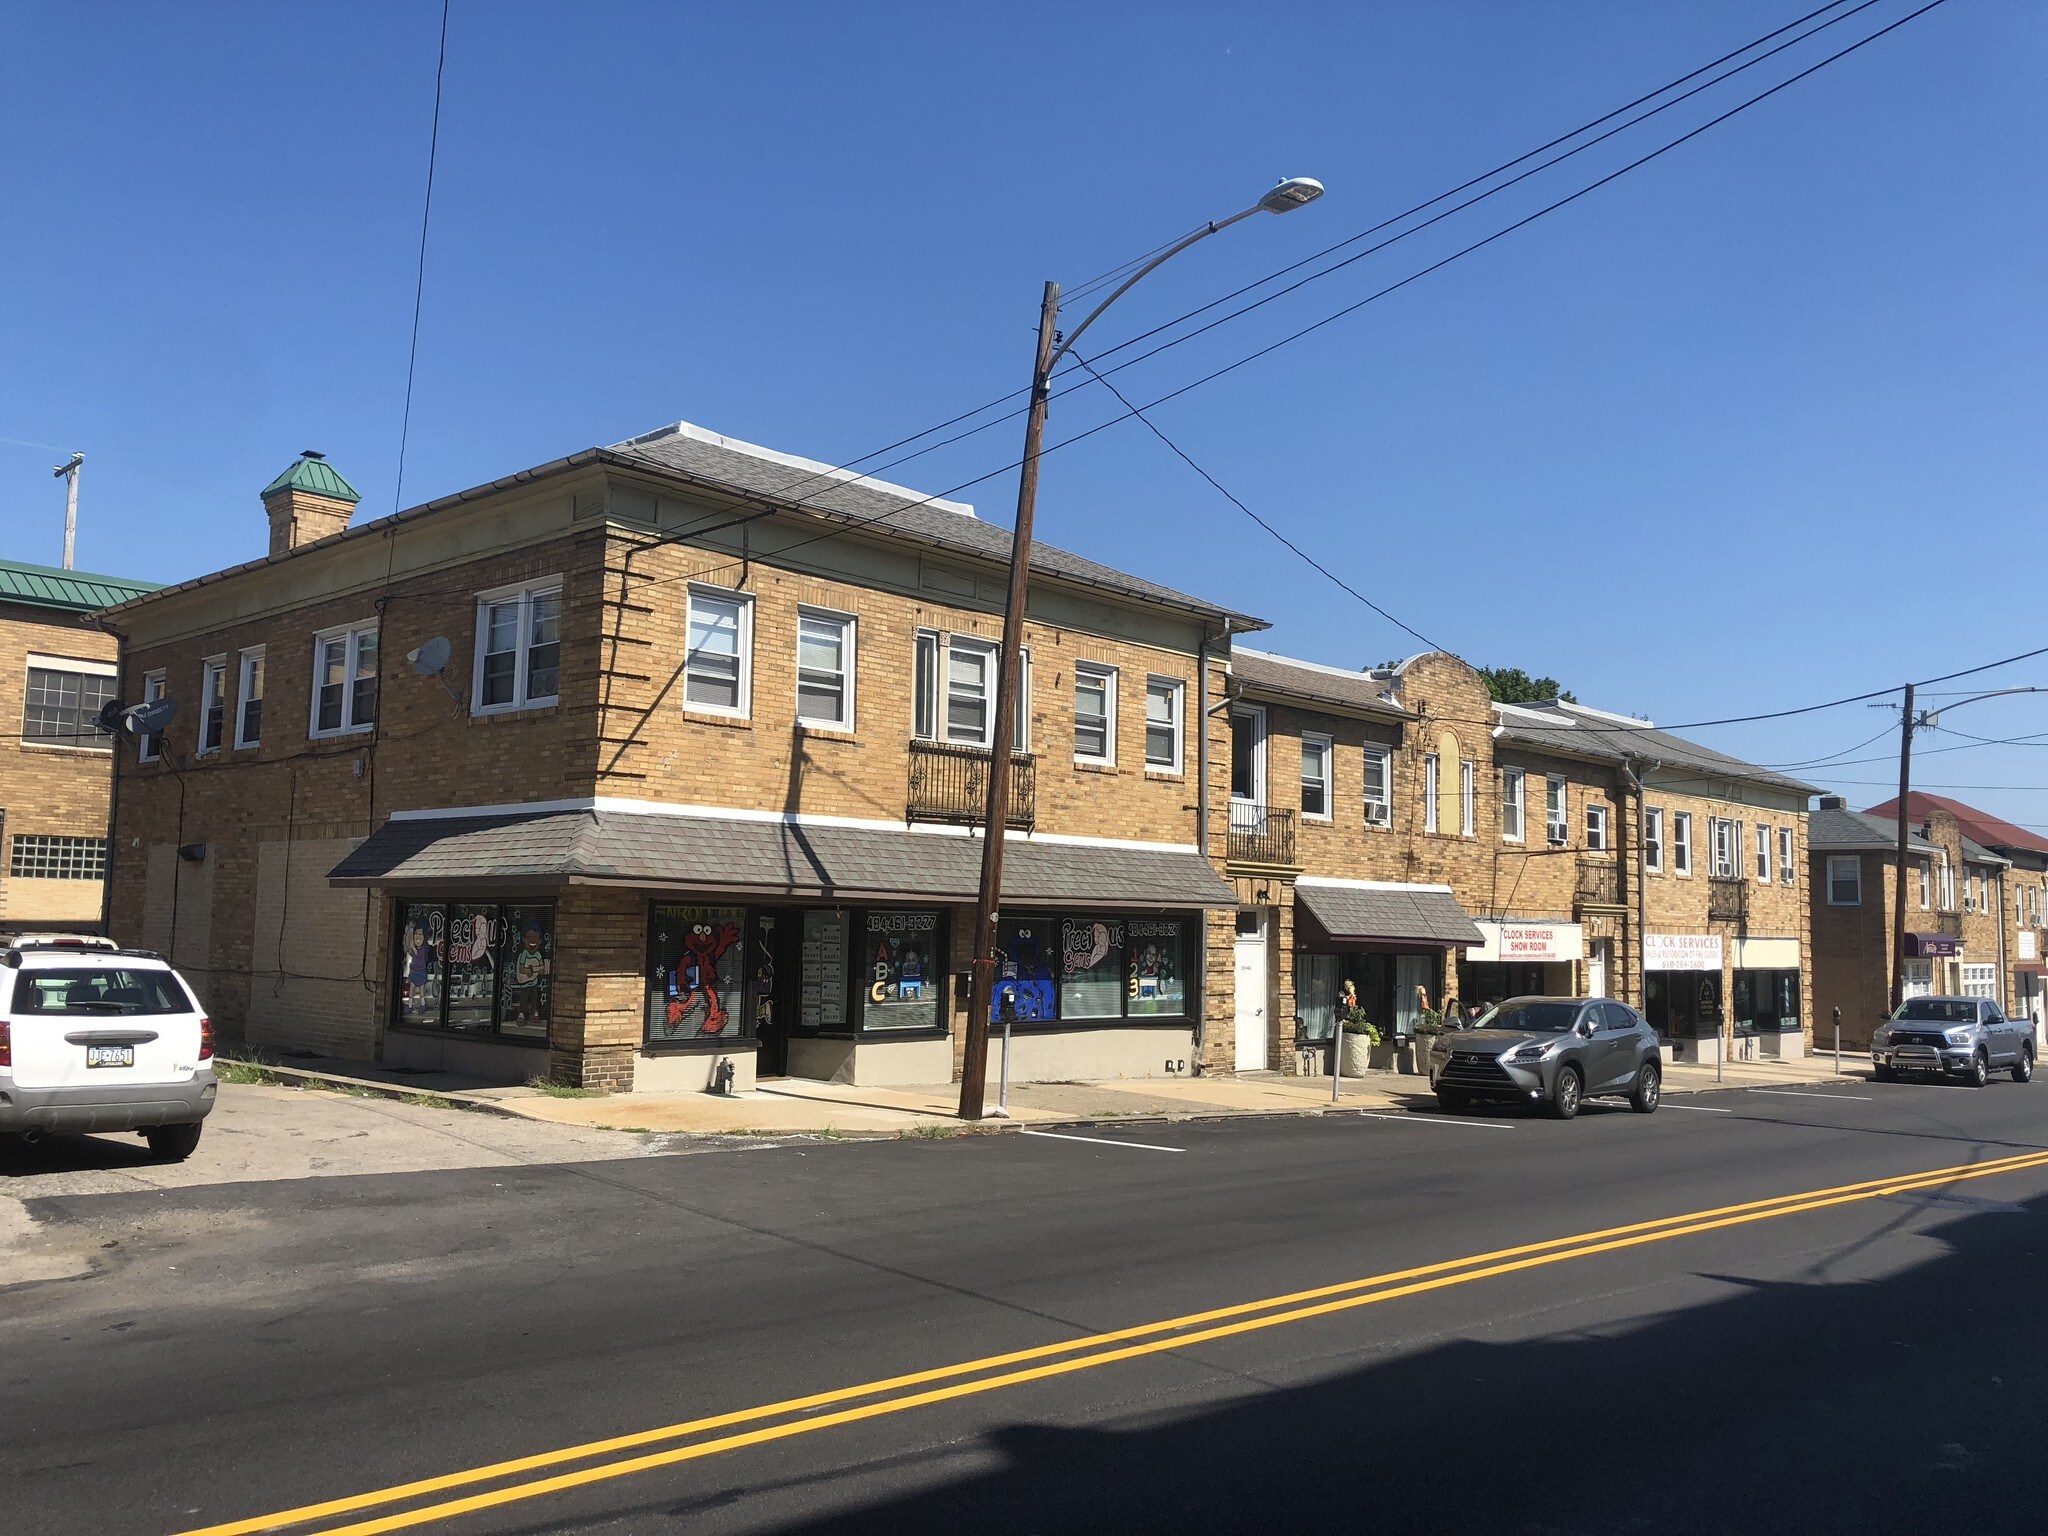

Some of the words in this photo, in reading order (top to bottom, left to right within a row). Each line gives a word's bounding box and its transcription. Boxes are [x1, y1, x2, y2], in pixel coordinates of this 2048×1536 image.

[1503, 929, 1524, 940] CLOCK
[1525, 930, 1553, 940] SERVICES
[1511, 942, 1528, 951] SHOW
[1529, 942, 1547, 951] ROOM
[1679, 937, 1719, 949] SERVICES
